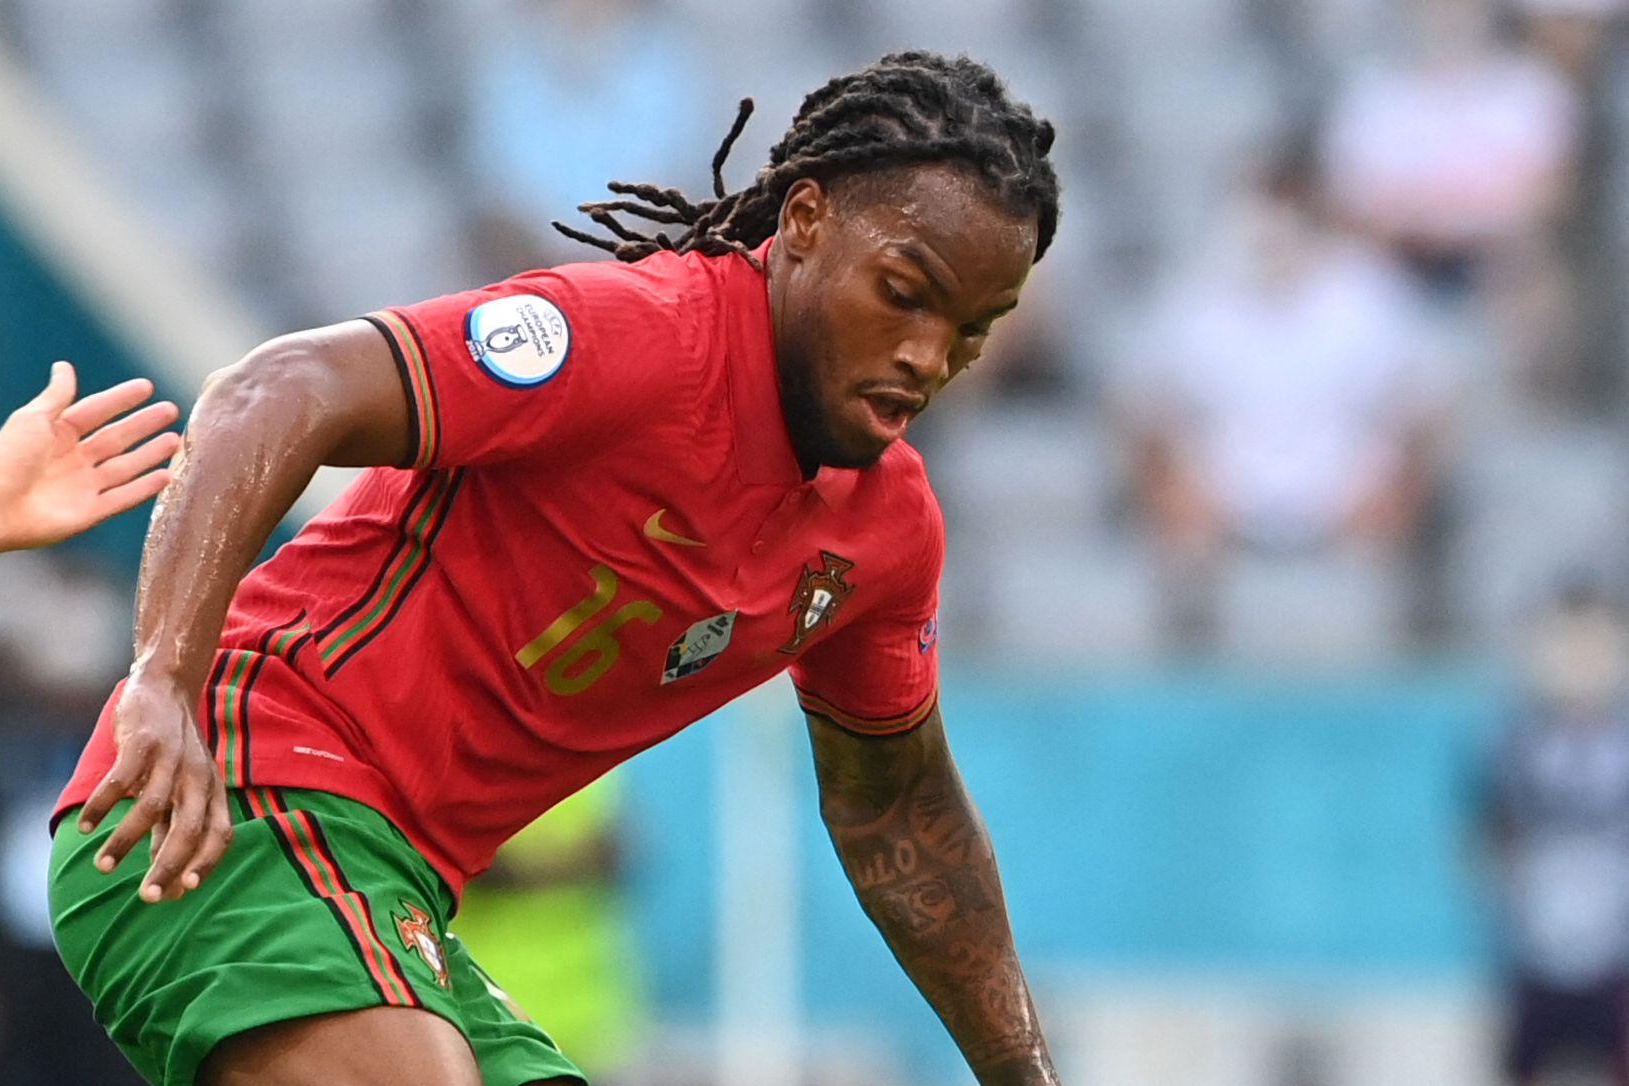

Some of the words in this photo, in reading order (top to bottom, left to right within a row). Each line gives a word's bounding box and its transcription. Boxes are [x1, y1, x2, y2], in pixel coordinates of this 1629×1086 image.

[516, 306, 546, 358] CHAMPIONS
[524, 304, 556, 355] EUROPEAN
[514, 563, 663, 695] 16
